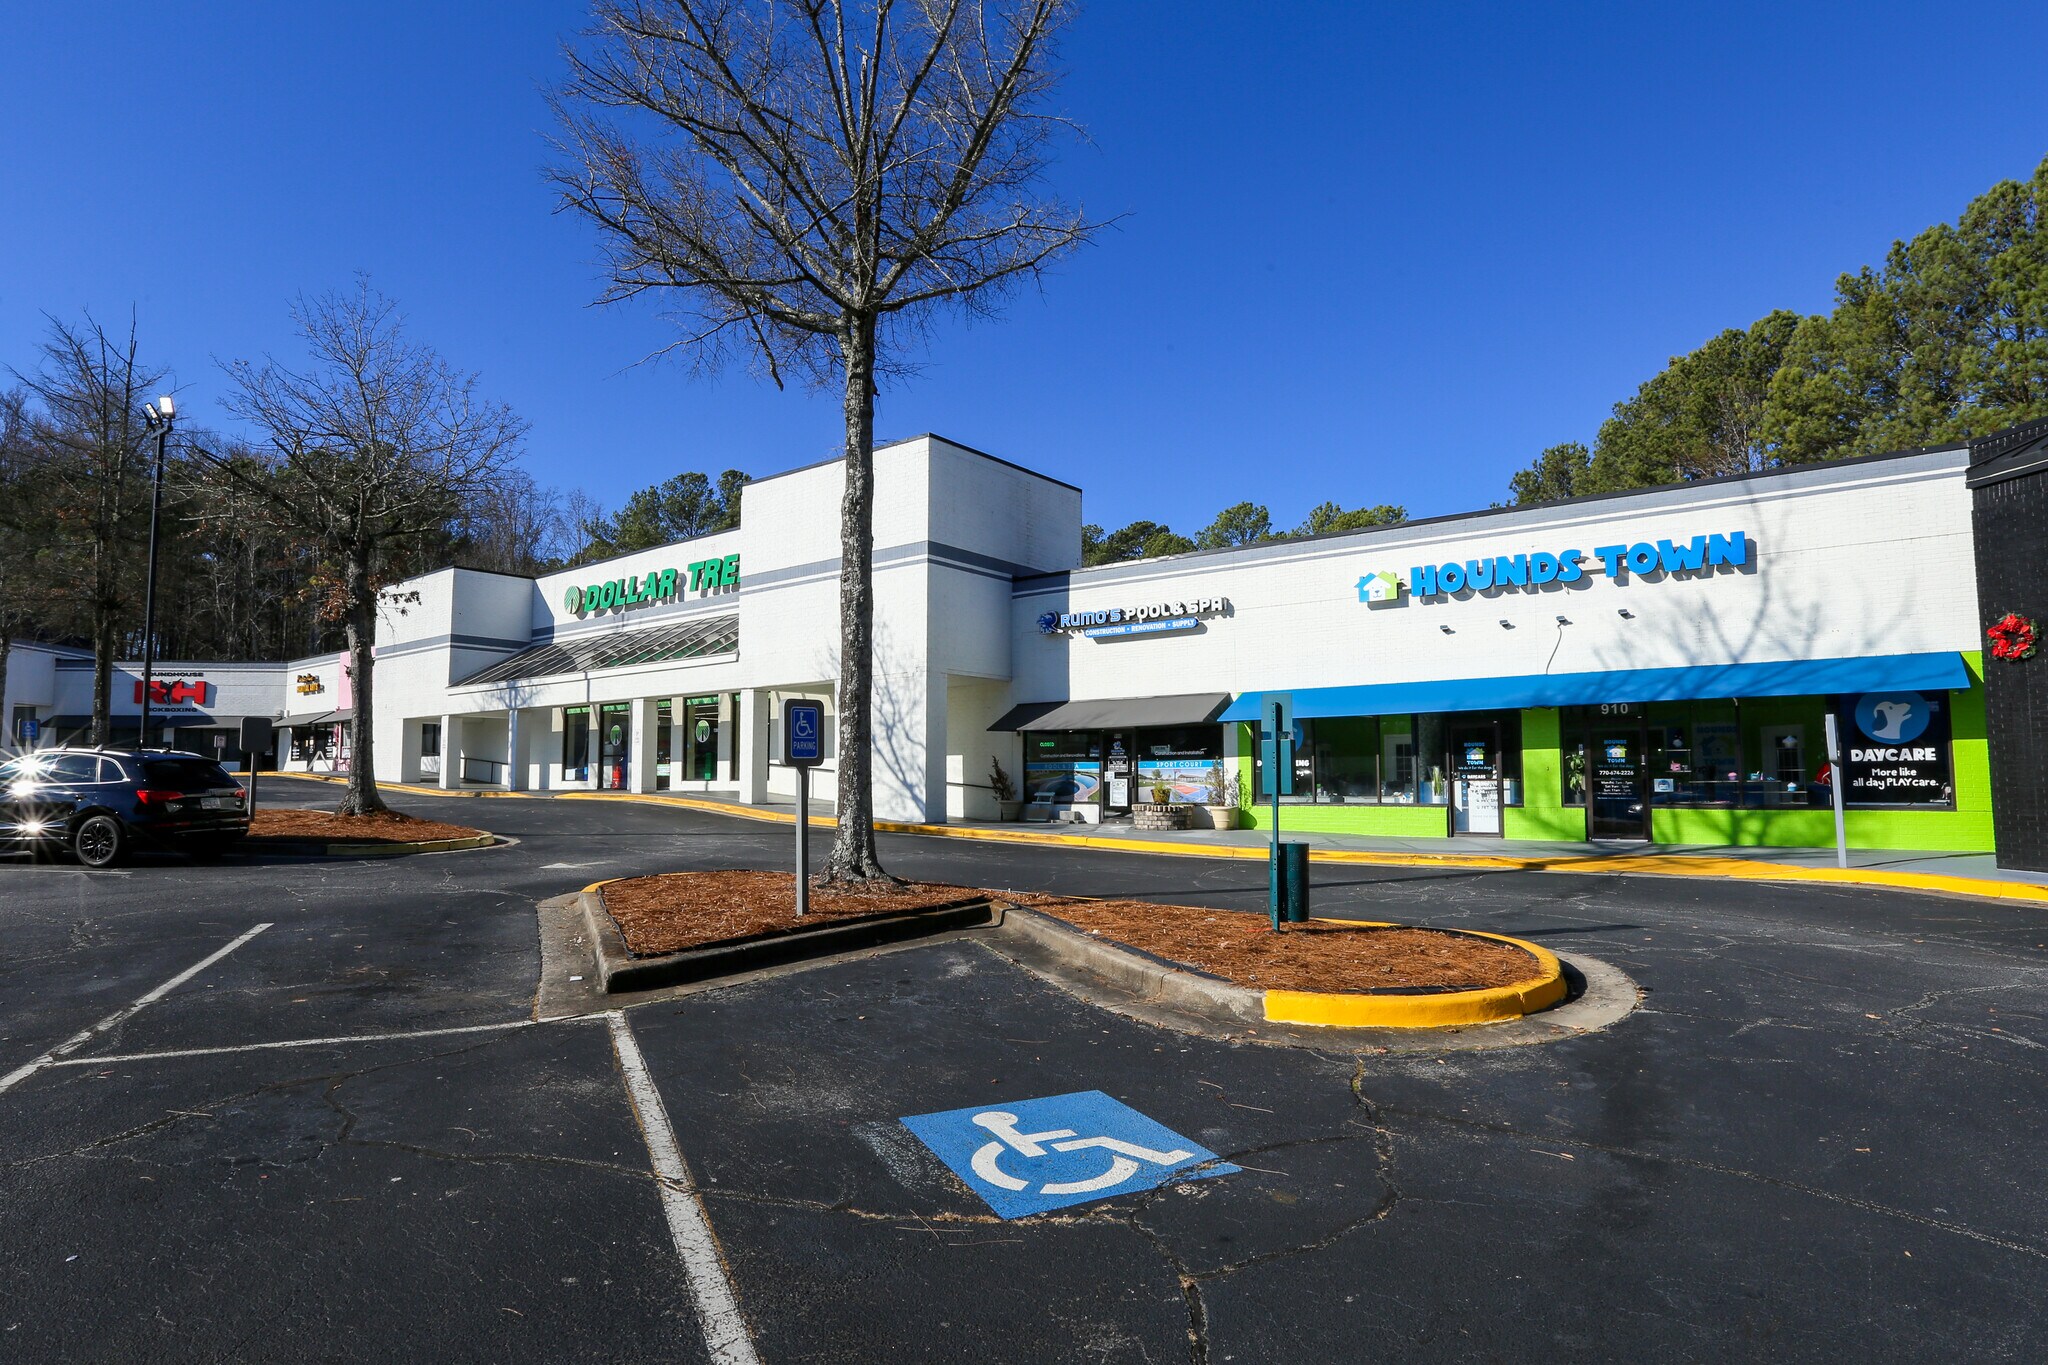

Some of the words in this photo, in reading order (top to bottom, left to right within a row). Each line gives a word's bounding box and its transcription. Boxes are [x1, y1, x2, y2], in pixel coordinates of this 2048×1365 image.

[1410, 549, 1582, 597] HOUNDS
[1594, 531, 1747, 578] TOWN
[584, 568, 678, 612] DOLLAR
[687, 553, 741, 592] TRE
[1060, 608, 1122, 628] RUMO'S
[1085, 627, 1126, 637] CONSTRUCTION
[1131, 623, 1166, 632] RENOVATION
[1172, 619, 1195, 629] SUPPLY
[1601, 703, 1629, 715] 910
[793, 741, 816, 750] PARKING
[1850, 747, 1936, 762] DAYCARE
[1871, 768, 1898, 776] More
[1898, 767, 1917, 776] like
[1852, 778, 1864, 786] all
[1866, 777, 1885, 789] day
